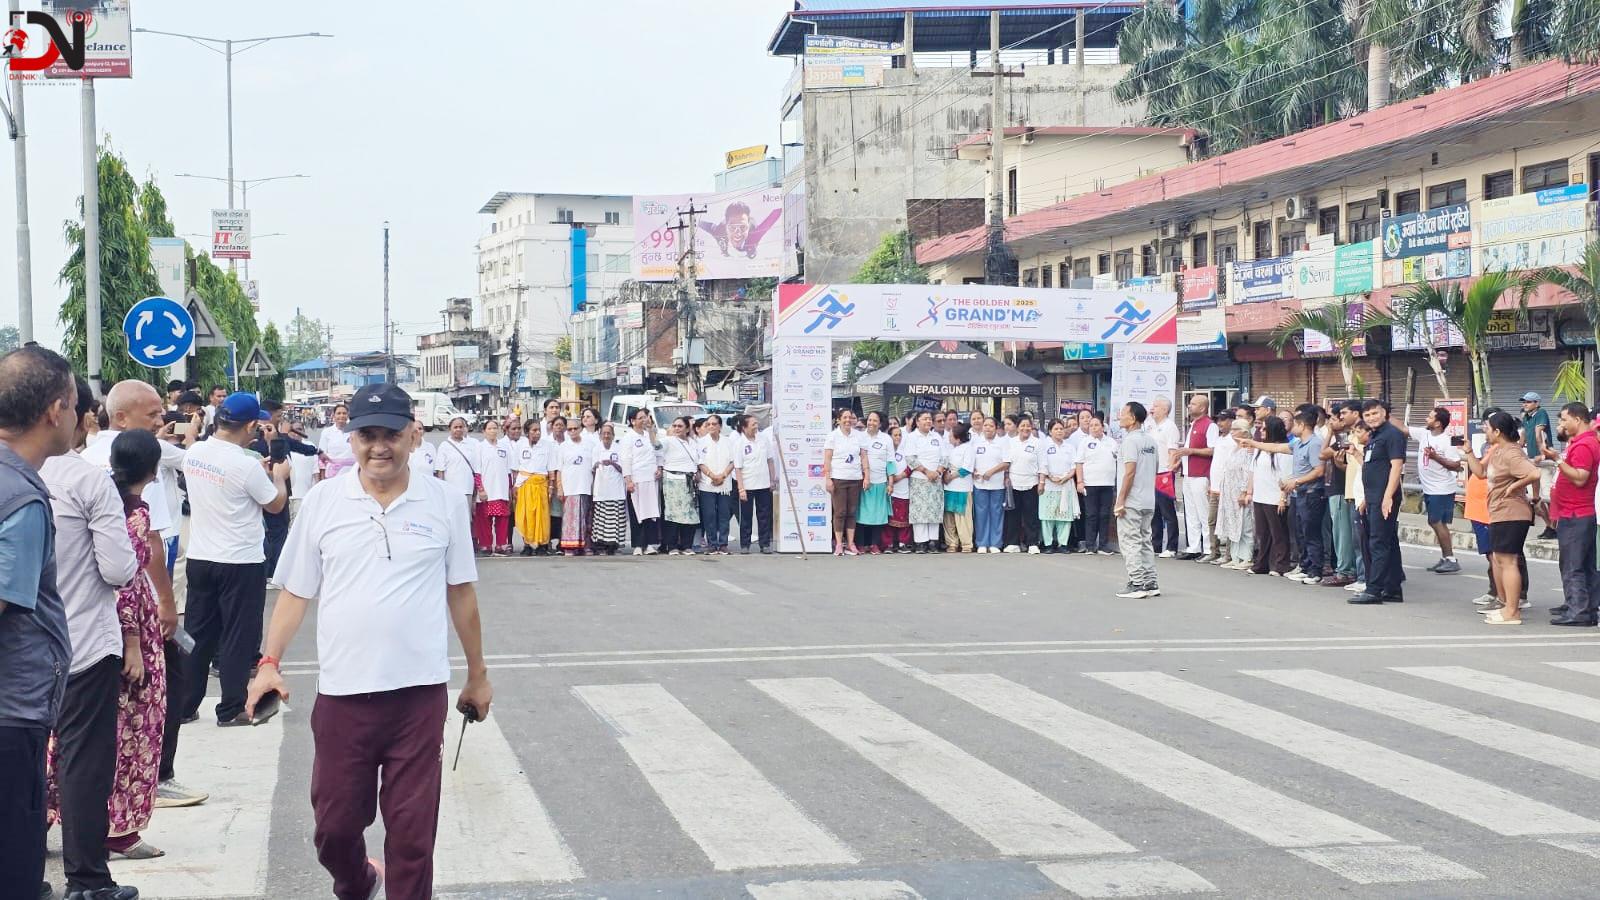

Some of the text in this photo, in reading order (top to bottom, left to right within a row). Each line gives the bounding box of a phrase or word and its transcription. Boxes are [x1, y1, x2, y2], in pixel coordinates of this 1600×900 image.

[214, 232, 233, 244] IT
[650, 230, 674, 248] 99
[952, 298, 1010, 307] THE GOLDEN
[926, 352, 977, 360] TREK
[908, 385, 1020, 395] NEPALGUNJ BICYCLES
